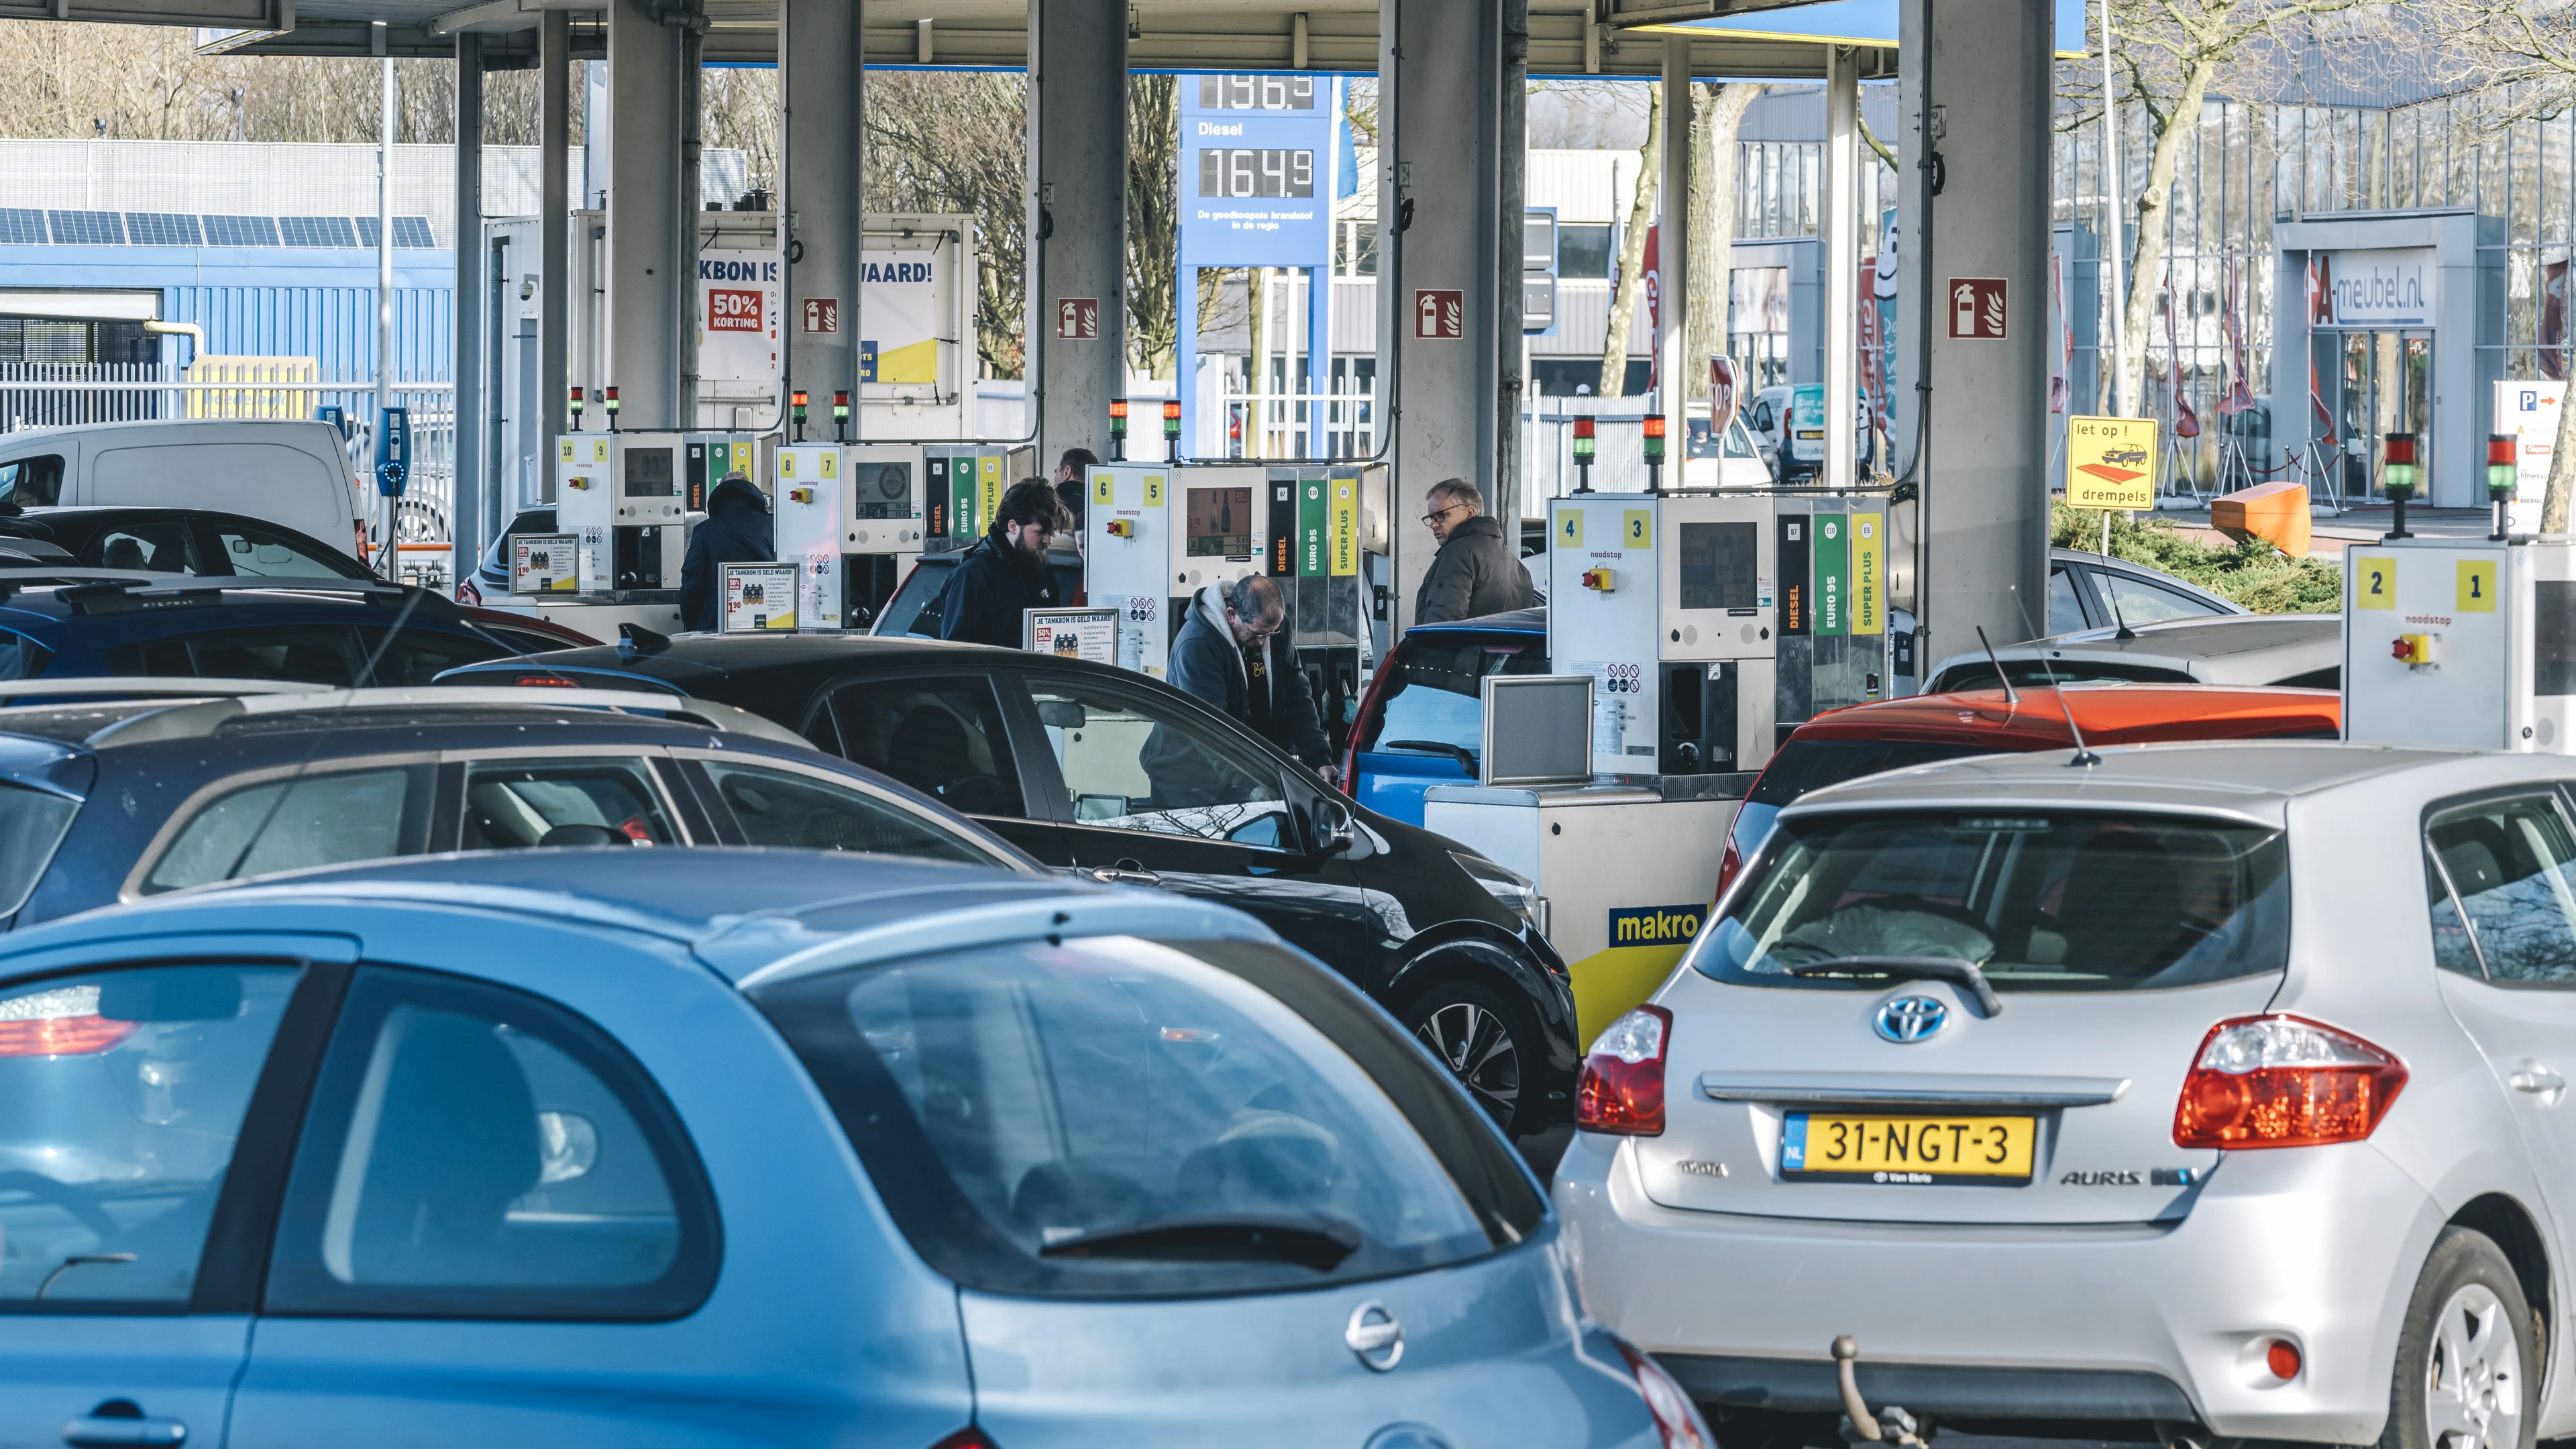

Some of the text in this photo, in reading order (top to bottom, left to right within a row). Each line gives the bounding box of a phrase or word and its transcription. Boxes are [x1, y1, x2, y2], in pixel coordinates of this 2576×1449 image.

[1198, 122, 1242, 136] Diesel
[1210, 150, 1312, 198] 164.9
[1198, 210, 1313, 220] De goedkoopste brandstof
[1243, 221, 1254, 229] de
[1257, 222, 1279, 231] regio
[2316, 256, 2424, 325] A-meubel.nl
[714, 294, 758, 315] 50%
[714, 317, 758, 328] KORTING
[2522, 392, 2534, 410] P
[2078, 424, 2127, 438] let op !
[564, 446, 603, 456] 10 9
[786, 460, 830, 471] 8 7
[1101, 482, 1157, 498] 6 5
[2083, 489, 2146, 503] drempels
[961, 498, 968, 509] 95
[1309, 529, 1317, 542] 95
[1566, 520, 1641, 537] 4 3
[1591, 551, 1622, 560] noodstop
[1863, 552, 1872, 626] SUPER PLUS
[2371, 572, 2481, 598] 2 1
[1790, 585, 1799, 628] DIESEL
[1827, 576, 1836, 628] EURO 95
[2406, 614, 2451, 627] noodstop
[1618, 911, 1698, 941] makro
[1826, 1122, 2008, 1164] 31-NGT-3
[1786, 1147, 1803, 1160] NL
[1889, 1173, 1907, 1182] Van
[2060, 1171, 2143, 1185] AURIS
